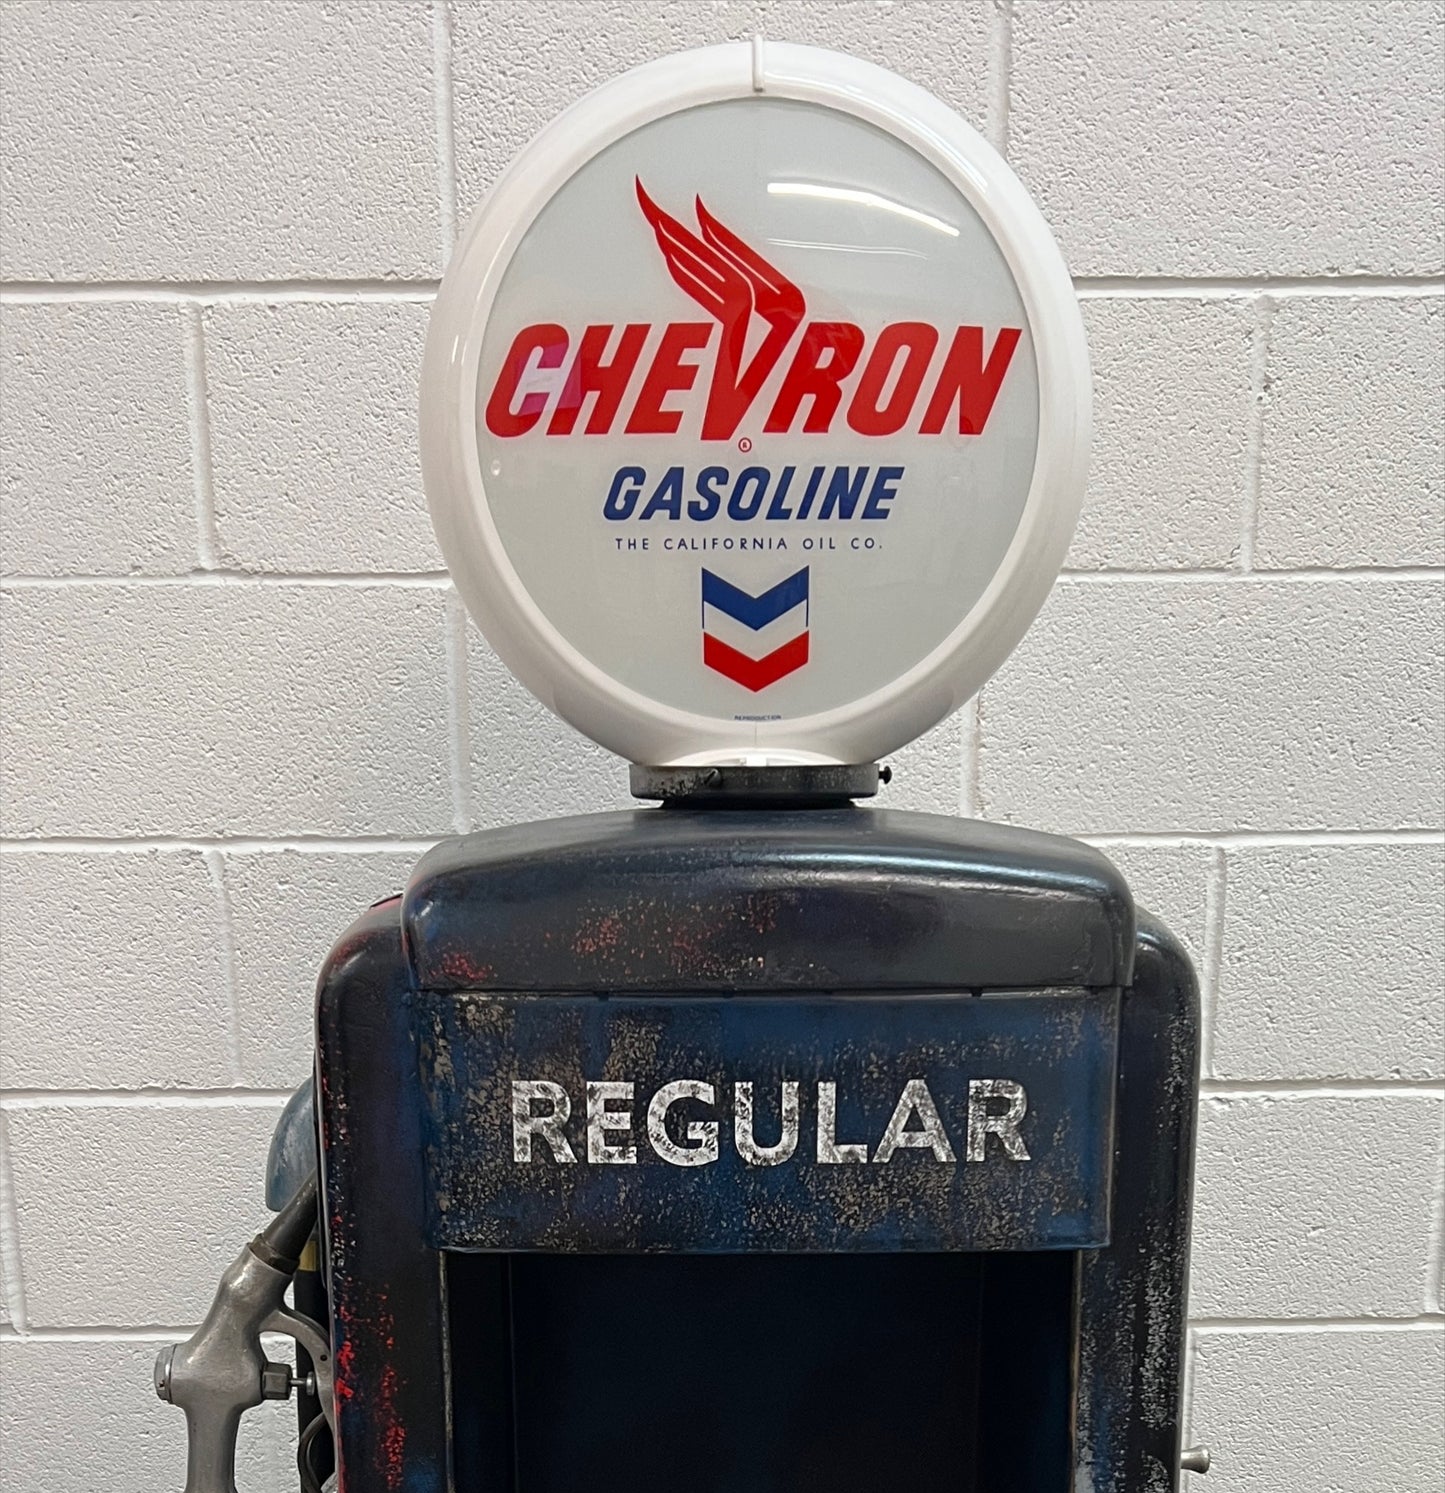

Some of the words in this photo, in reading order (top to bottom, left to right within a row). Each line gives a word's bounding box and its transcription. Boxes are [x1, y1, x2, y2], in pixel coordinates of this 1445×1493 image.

[485, 304, 1022, 441] CHEVRON
[602, 466, 905, 520] GASOLINE
[615, 537, 649, 550] THE
[664, 537, 788, 550] CALIFORNIA
[802, 537, 836, 550] OIL
[850, 537, 883, 550] CO.
[511, 1078, 1032, 1167] REGULAR
